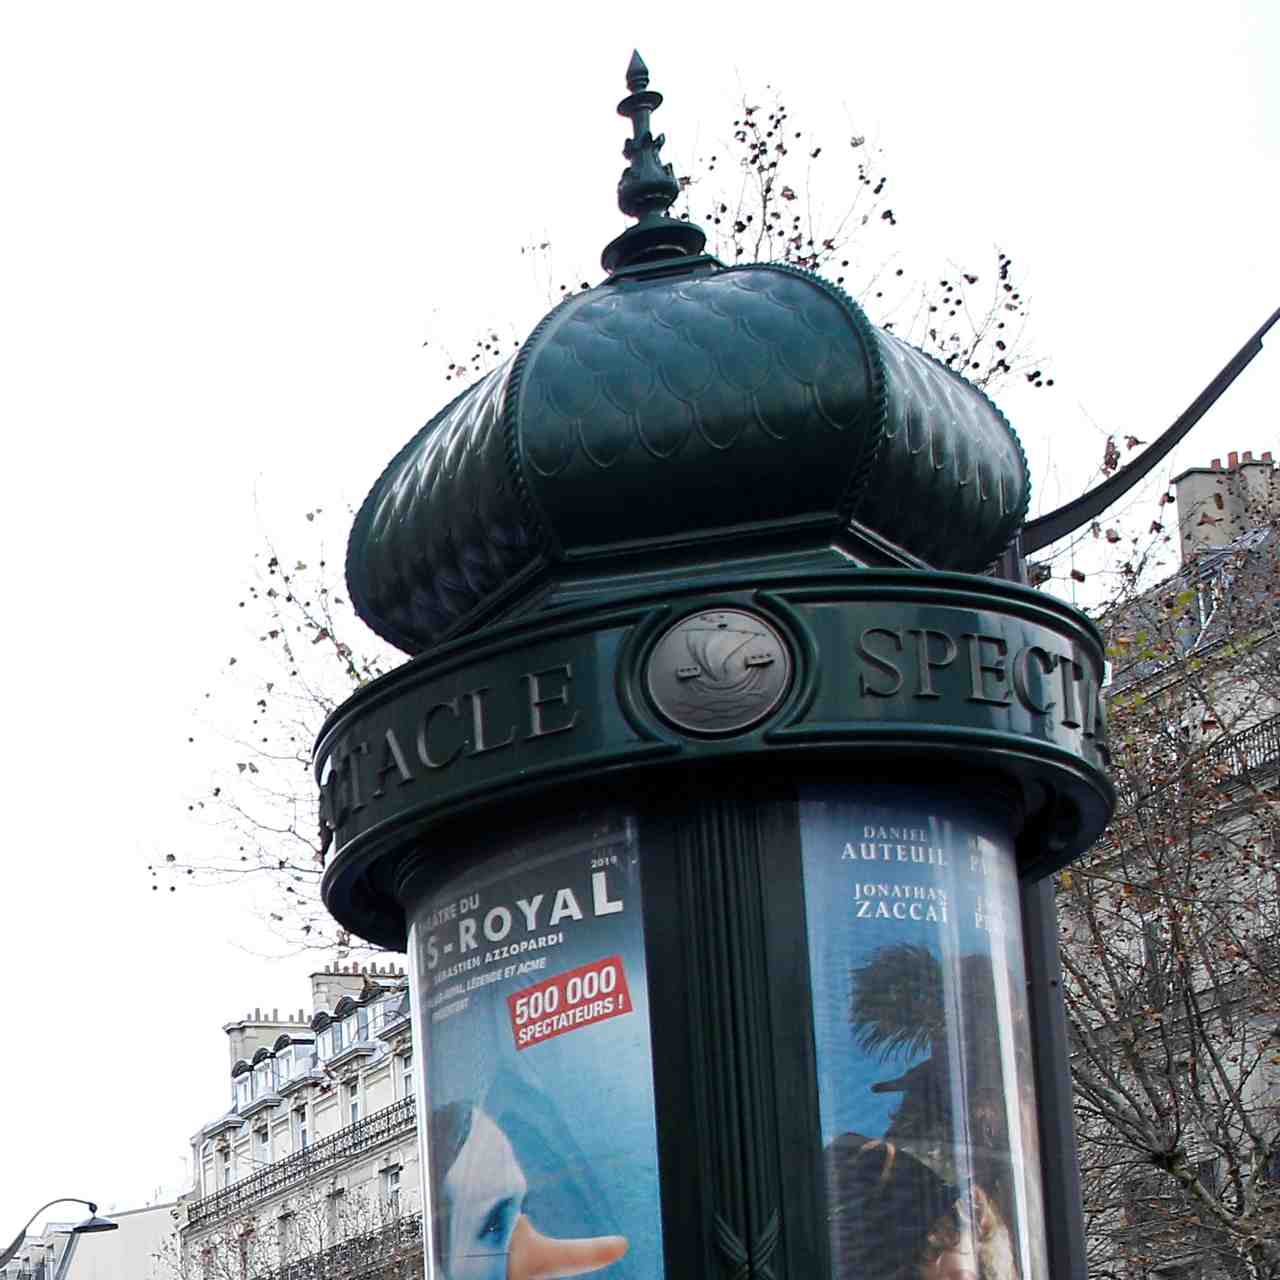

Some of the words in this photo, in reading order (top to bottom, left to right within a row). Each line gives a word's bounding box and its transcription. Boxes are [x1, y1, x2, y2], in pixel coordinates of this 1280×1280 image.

[333, 662, 582, 822] TACLE
[863, 825, 929, 843] DANIEL
[841, 842, 948, 866] AUTEUIL
[460, 893, 480, 914] DU
[854, 883, 946, 902] JONATHAN
[485, 931, 564, 965] AZZOPARDI
[515, 985, 560, 1025] 500
[566, 965, 617, 1004] 000
[518, 998, 614, 1045] SPECTATEURS
